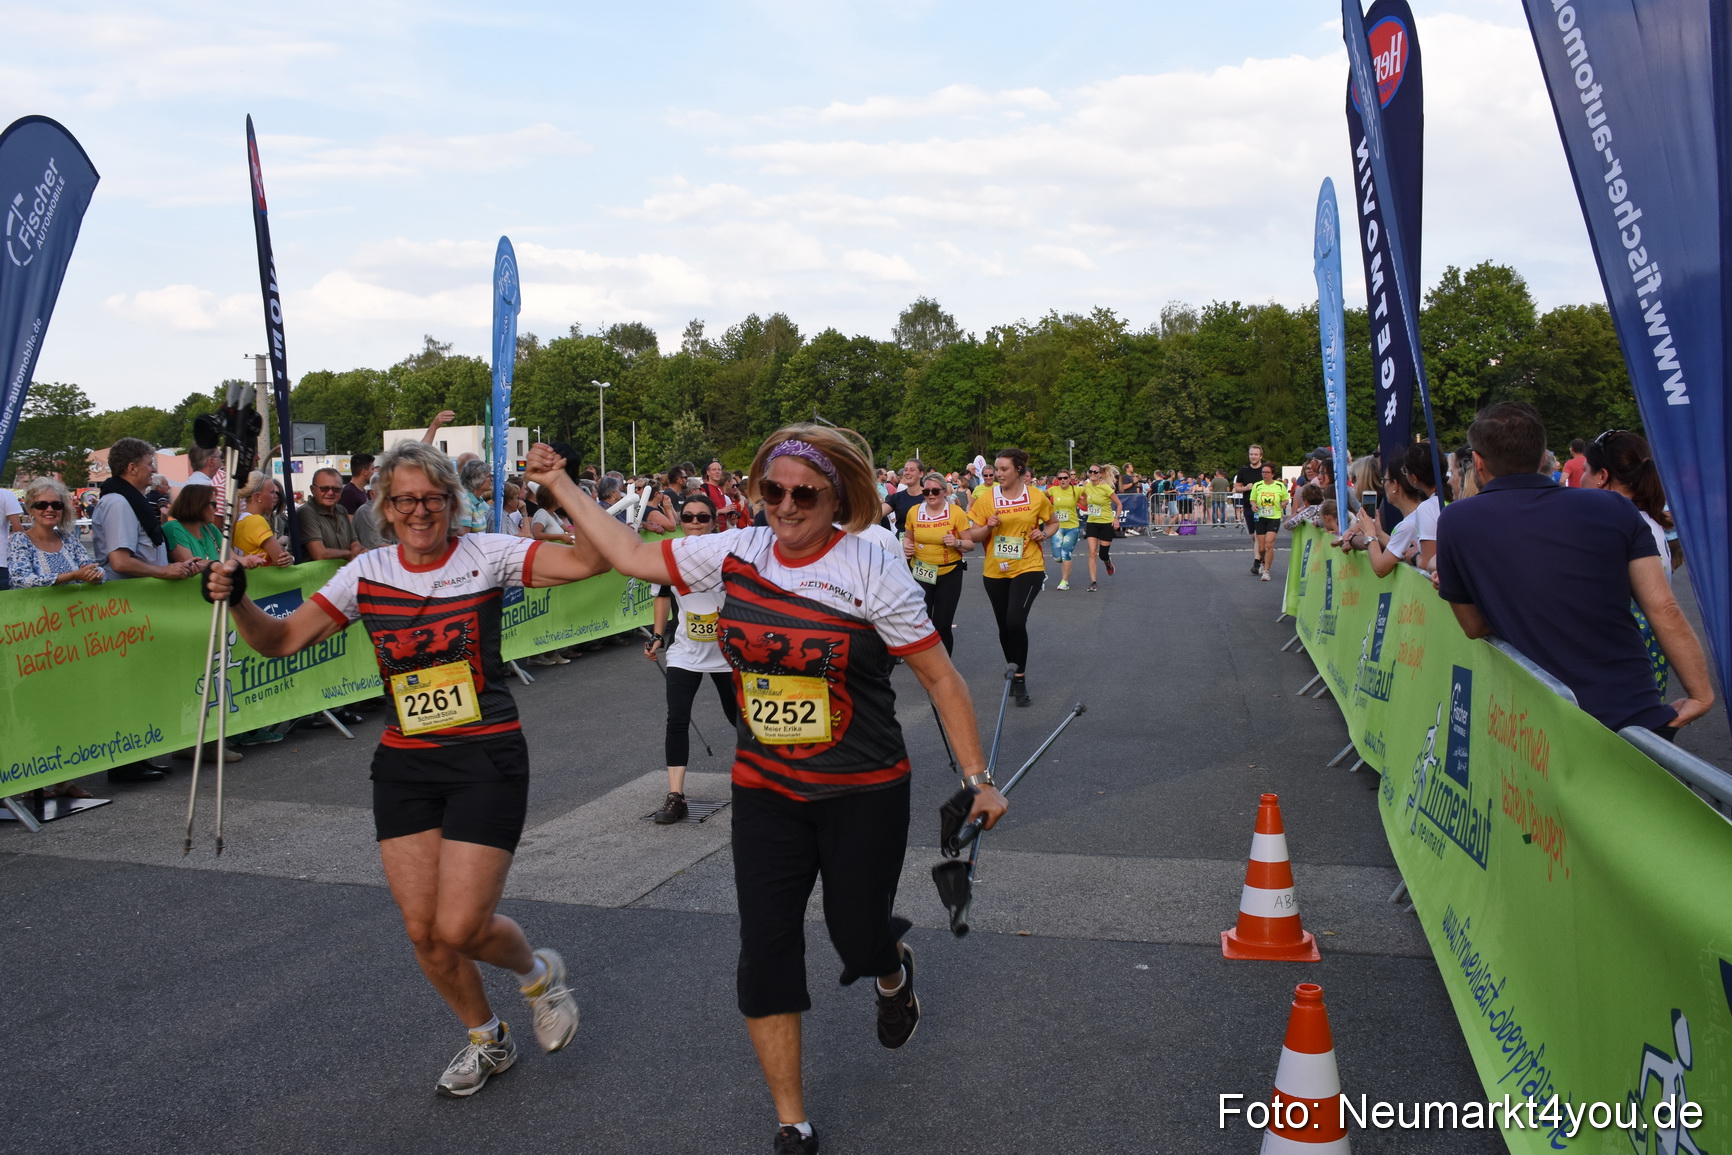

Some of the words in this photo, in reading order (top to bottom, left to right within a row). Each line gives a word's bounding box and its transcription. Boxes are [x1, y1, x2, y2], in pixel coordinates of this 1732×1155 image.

[18, 157, 58, 250] Fischer
[36, 176, 66, 250] AUTOMOBILE
[997, 544, 1019, 553] 1594
[915, 566, 934, 578] 1576
[67, 598, 133, 628] Firmen
[16, 640, 81, 678] laufen
[84, 614, 155, 658] länger!
[244, 676, 295, 706] neumarkt
[404, 685, 463, 717] 2261
[751, 698, 817, 725] 2252
[1424, 757, 1493, 869] firmenlauf
[1418, 822, 1448, 861] neumarkt
